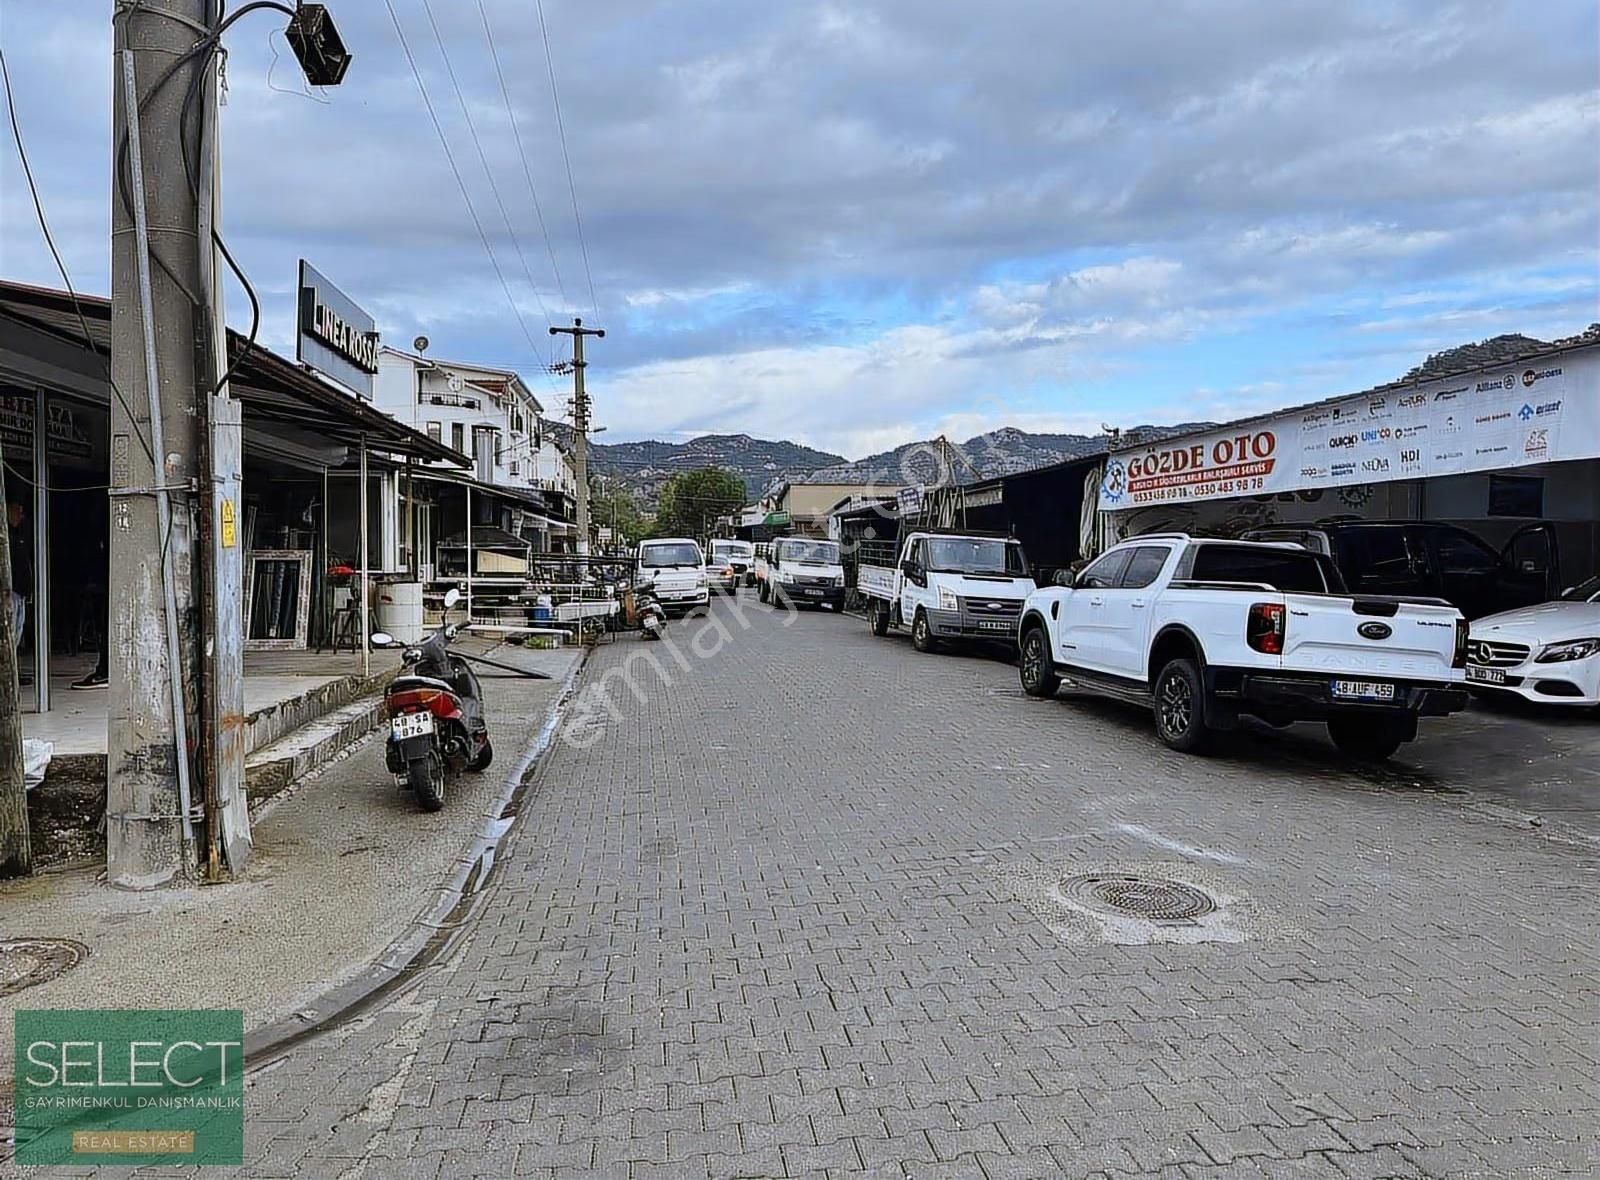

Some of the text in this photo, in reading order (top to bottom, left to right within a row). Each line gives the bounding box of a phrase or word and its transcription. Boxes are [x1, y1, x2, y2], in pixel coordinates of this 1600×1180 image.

[310, 287, 347, 352] LINEA
[1127, 431, 1276, 479] GÖZDE OTO
[1400, 449, 1420, 463] HDI
[1241, 462, 1266, 475] SERVİS
[1194, 485, 1216, 496] 0530
[1236, 479, 1249, 491] 98
[1252, 477, 1264, 489] 78
[1375, 685, 1392, 697] 459
